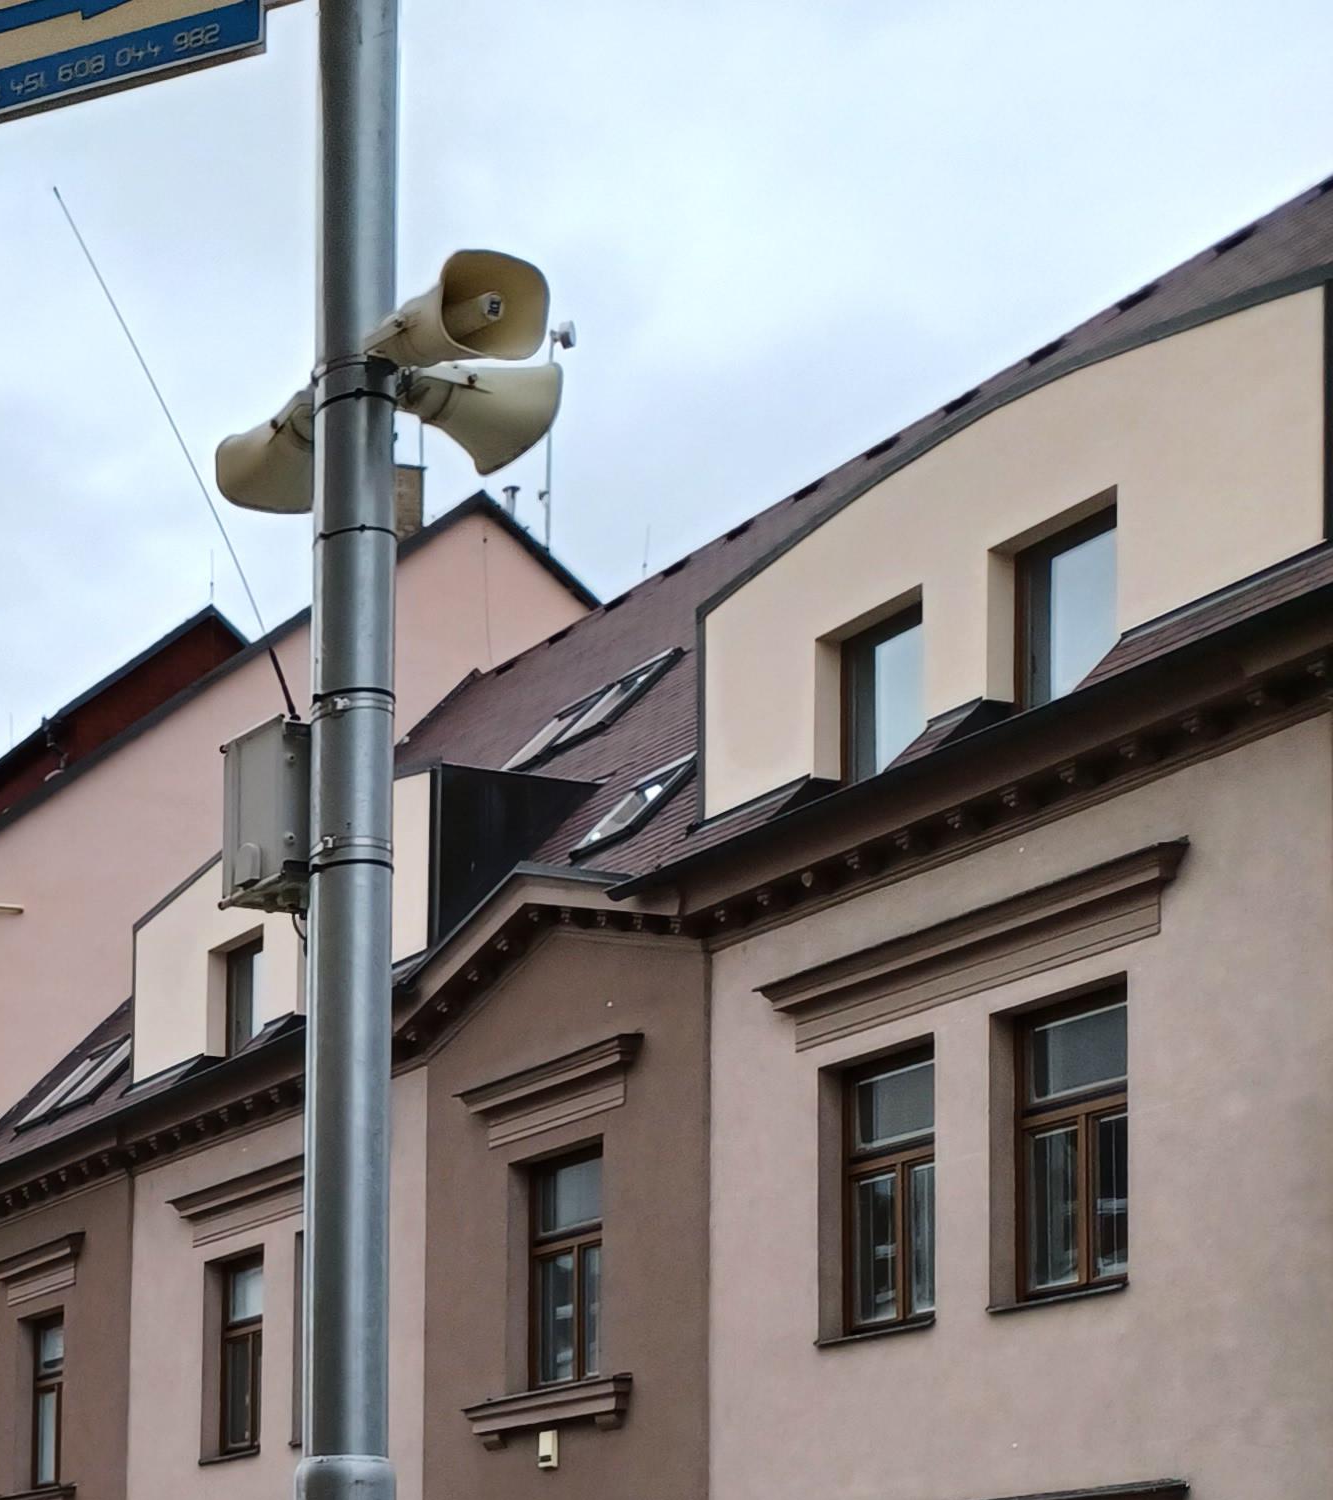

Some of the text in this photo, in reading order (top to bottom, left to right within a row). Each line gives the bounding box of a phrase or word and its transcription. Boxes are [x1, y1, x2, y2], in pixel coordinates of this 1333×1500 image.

[57, 54, 106, 83] 608
[115, 43, 163, 69] 044
[172, 23, 221, 53] 982
